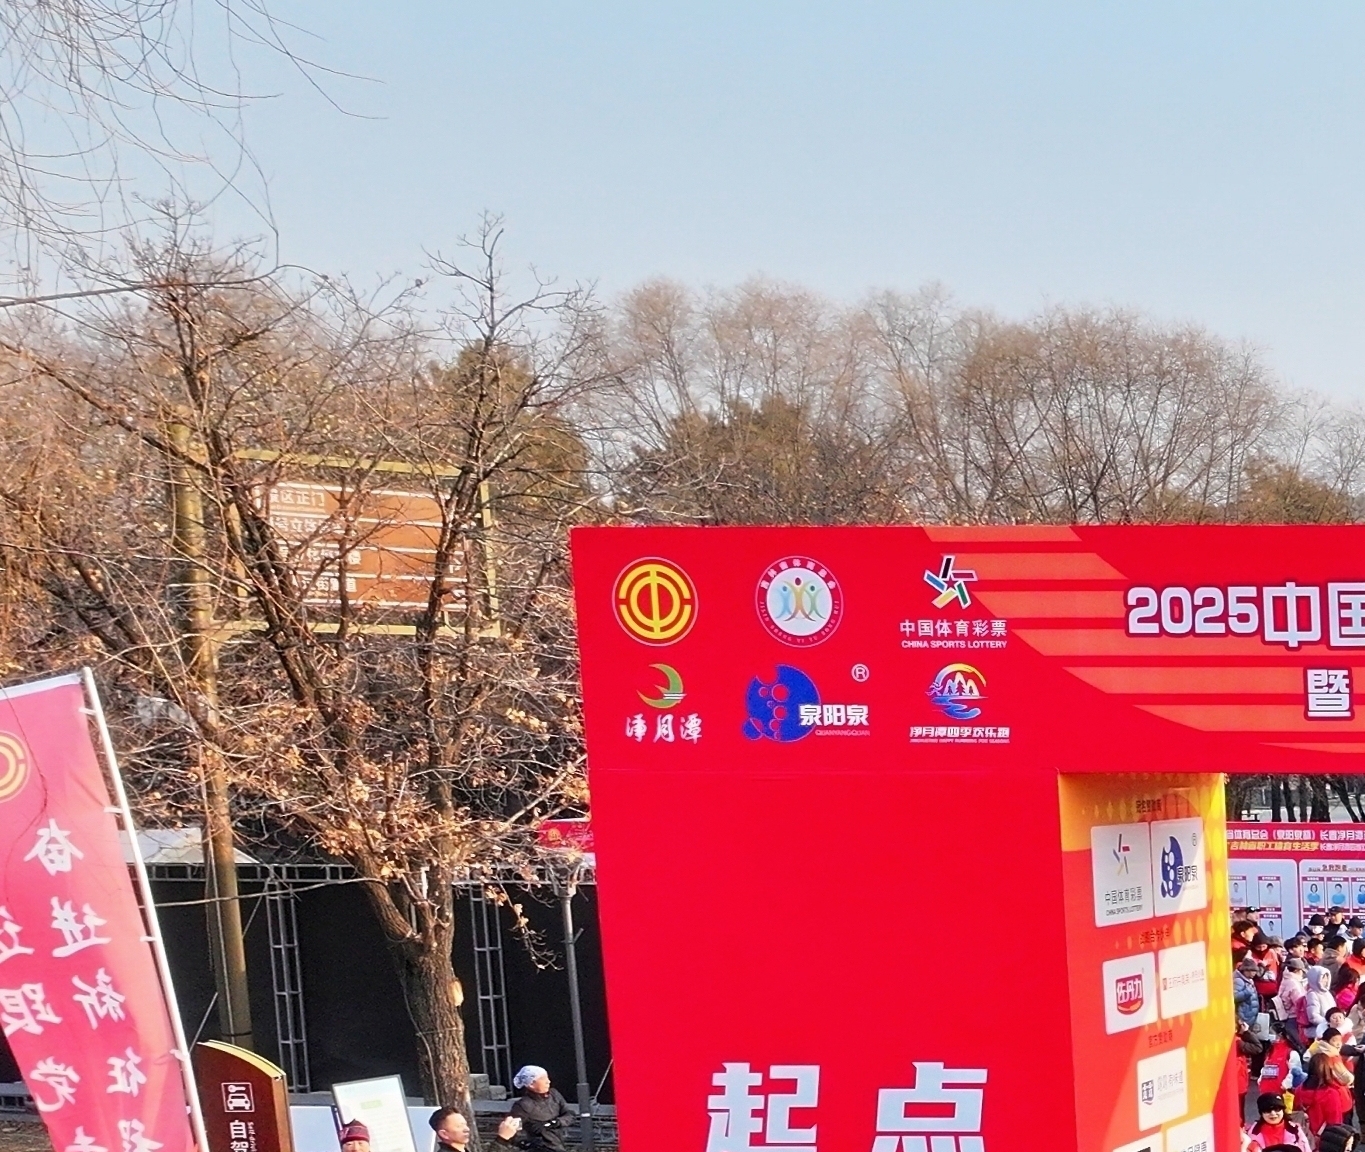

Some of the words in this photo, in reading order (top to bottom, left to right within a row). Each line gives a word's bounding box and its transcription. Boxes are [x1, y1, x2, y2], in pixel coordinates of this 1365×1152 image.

[900, 619, 1008, 637] 中国体育彩票
[901, 640, 928, 649] CHINA
[930, 640, 967, 649] SPORTS
[968, 640, 1008, 649] LOTTERY
[799, 704, 870, 727] 泉阳泉
[1116, 978, 1143, 1004] 佐丹力
